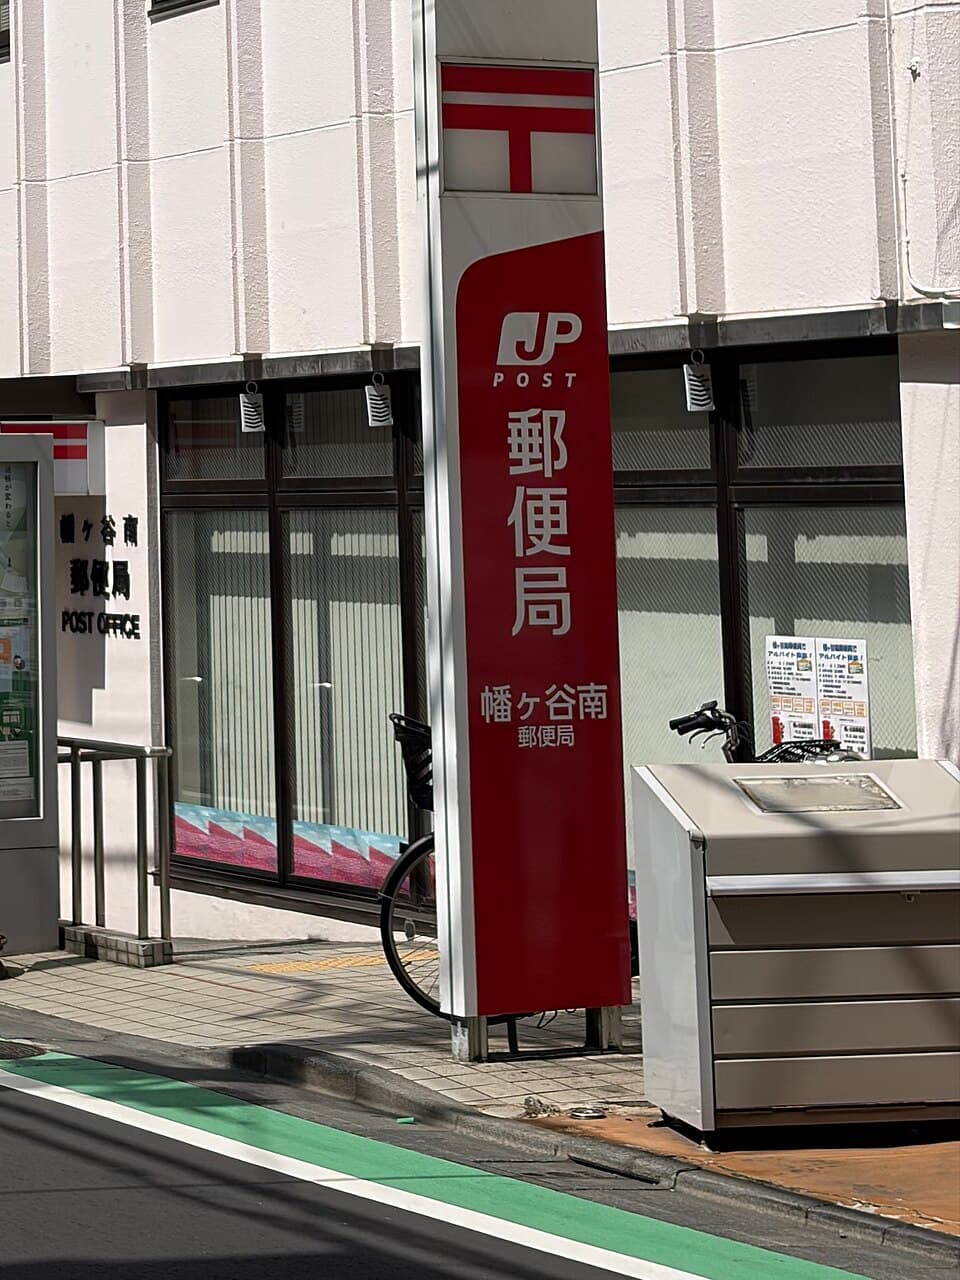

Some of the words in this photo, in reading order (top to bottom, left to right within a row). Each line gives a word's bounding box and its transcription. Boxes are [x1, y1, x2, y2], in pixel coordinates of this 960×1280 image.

[496, 312, 583, 366] JP
[492, 372, 577, 388] POST
[507, 408, 572, 637] 郵便局
[61, 611, 95, 634] POST
[97, 612, 141, 640] OFFICE
[481, 683, 608, 724] 幡ヶ谷南
[518, 725, 575, 748] 郵便局
